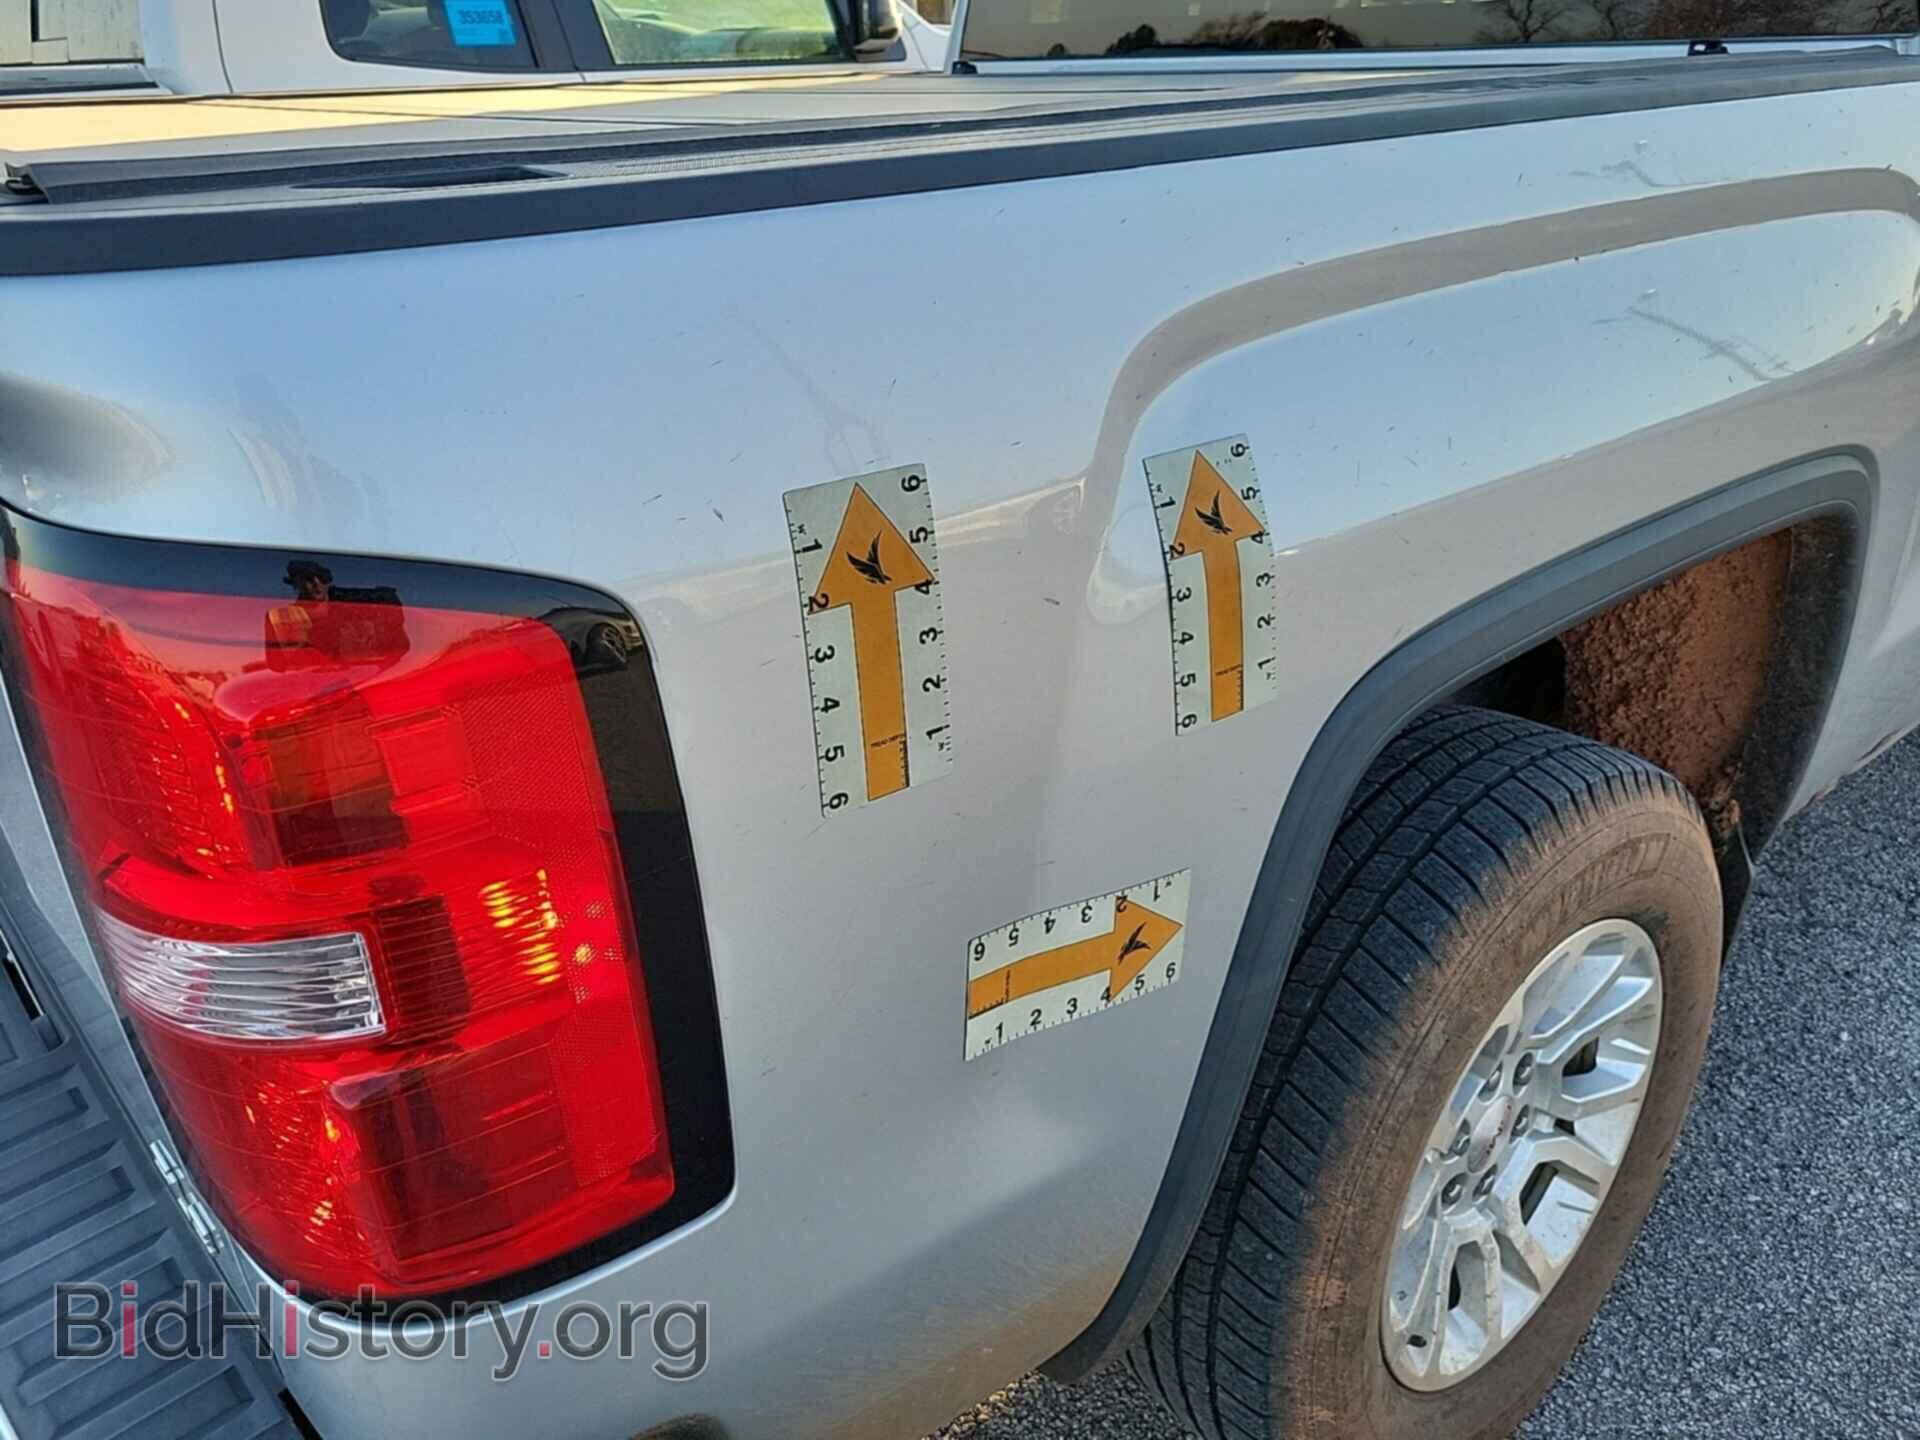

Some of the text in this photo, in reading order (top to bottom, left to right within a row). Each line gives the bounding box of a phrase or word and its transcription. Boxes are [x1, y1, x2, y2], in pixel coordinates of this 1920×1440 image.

[901, 475, 921, 492] 6
[909, 527, 928, 543] 5
[802, 538, 822, 553] 1
[1231, 443, 1272, 669] 6 5 4 3 2 1
[915, 579, 932, 595] 4
[809, 593, 829, 612] 2
[1160, 496, 1197, 728] 1 2 3 4 5 6
[919, 627, 938, 644] 3
[815, 645, 835, 663] 3
[922, 675, 941, 692] 2
[821, 697, 840, 713] 4
[926, 726, 944, 740] 1
[825, 745, 844, 762] 5
[829, 793, 849, 809] 6
[974, 885, 1160, 961] 1 2 3 4 5 6
[995, 962, 1176, 1038] 1 2 3 4 5 6
